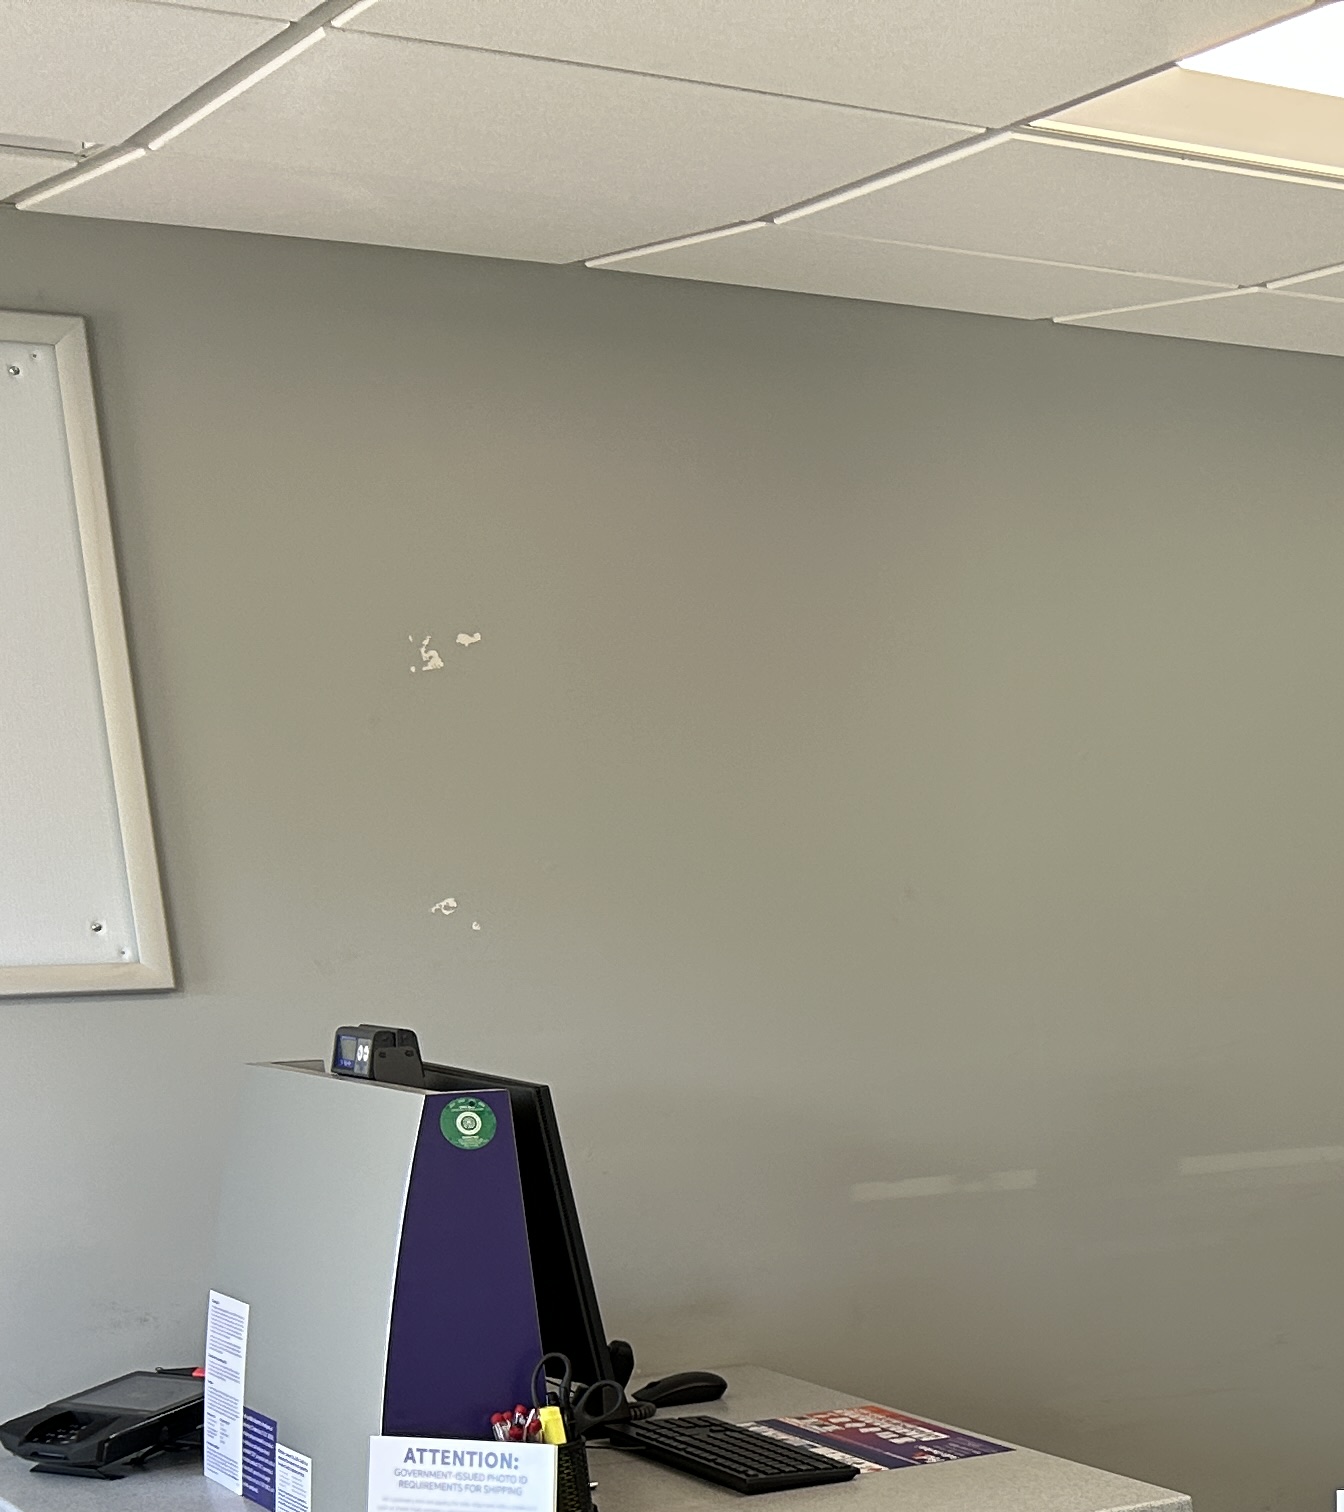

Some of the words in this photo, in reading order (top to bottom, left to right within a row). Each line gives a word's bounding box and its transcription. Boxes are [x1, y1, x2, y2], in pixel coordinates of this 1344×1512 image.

[404, 1448, 519, 1470] ATTENTION:
[394, 1468, 485, 1482] GOVERNMENT-ISSUED
[487, 1474, 517, 1484] PHOTO
[518, 1476, 527, 1484] ID
[398, 1480, 463, 1493] REQUIREMENTS
[464, 1483, 481, 1494] FOR
[484, 1484, 522, 1496] SHIPPING
